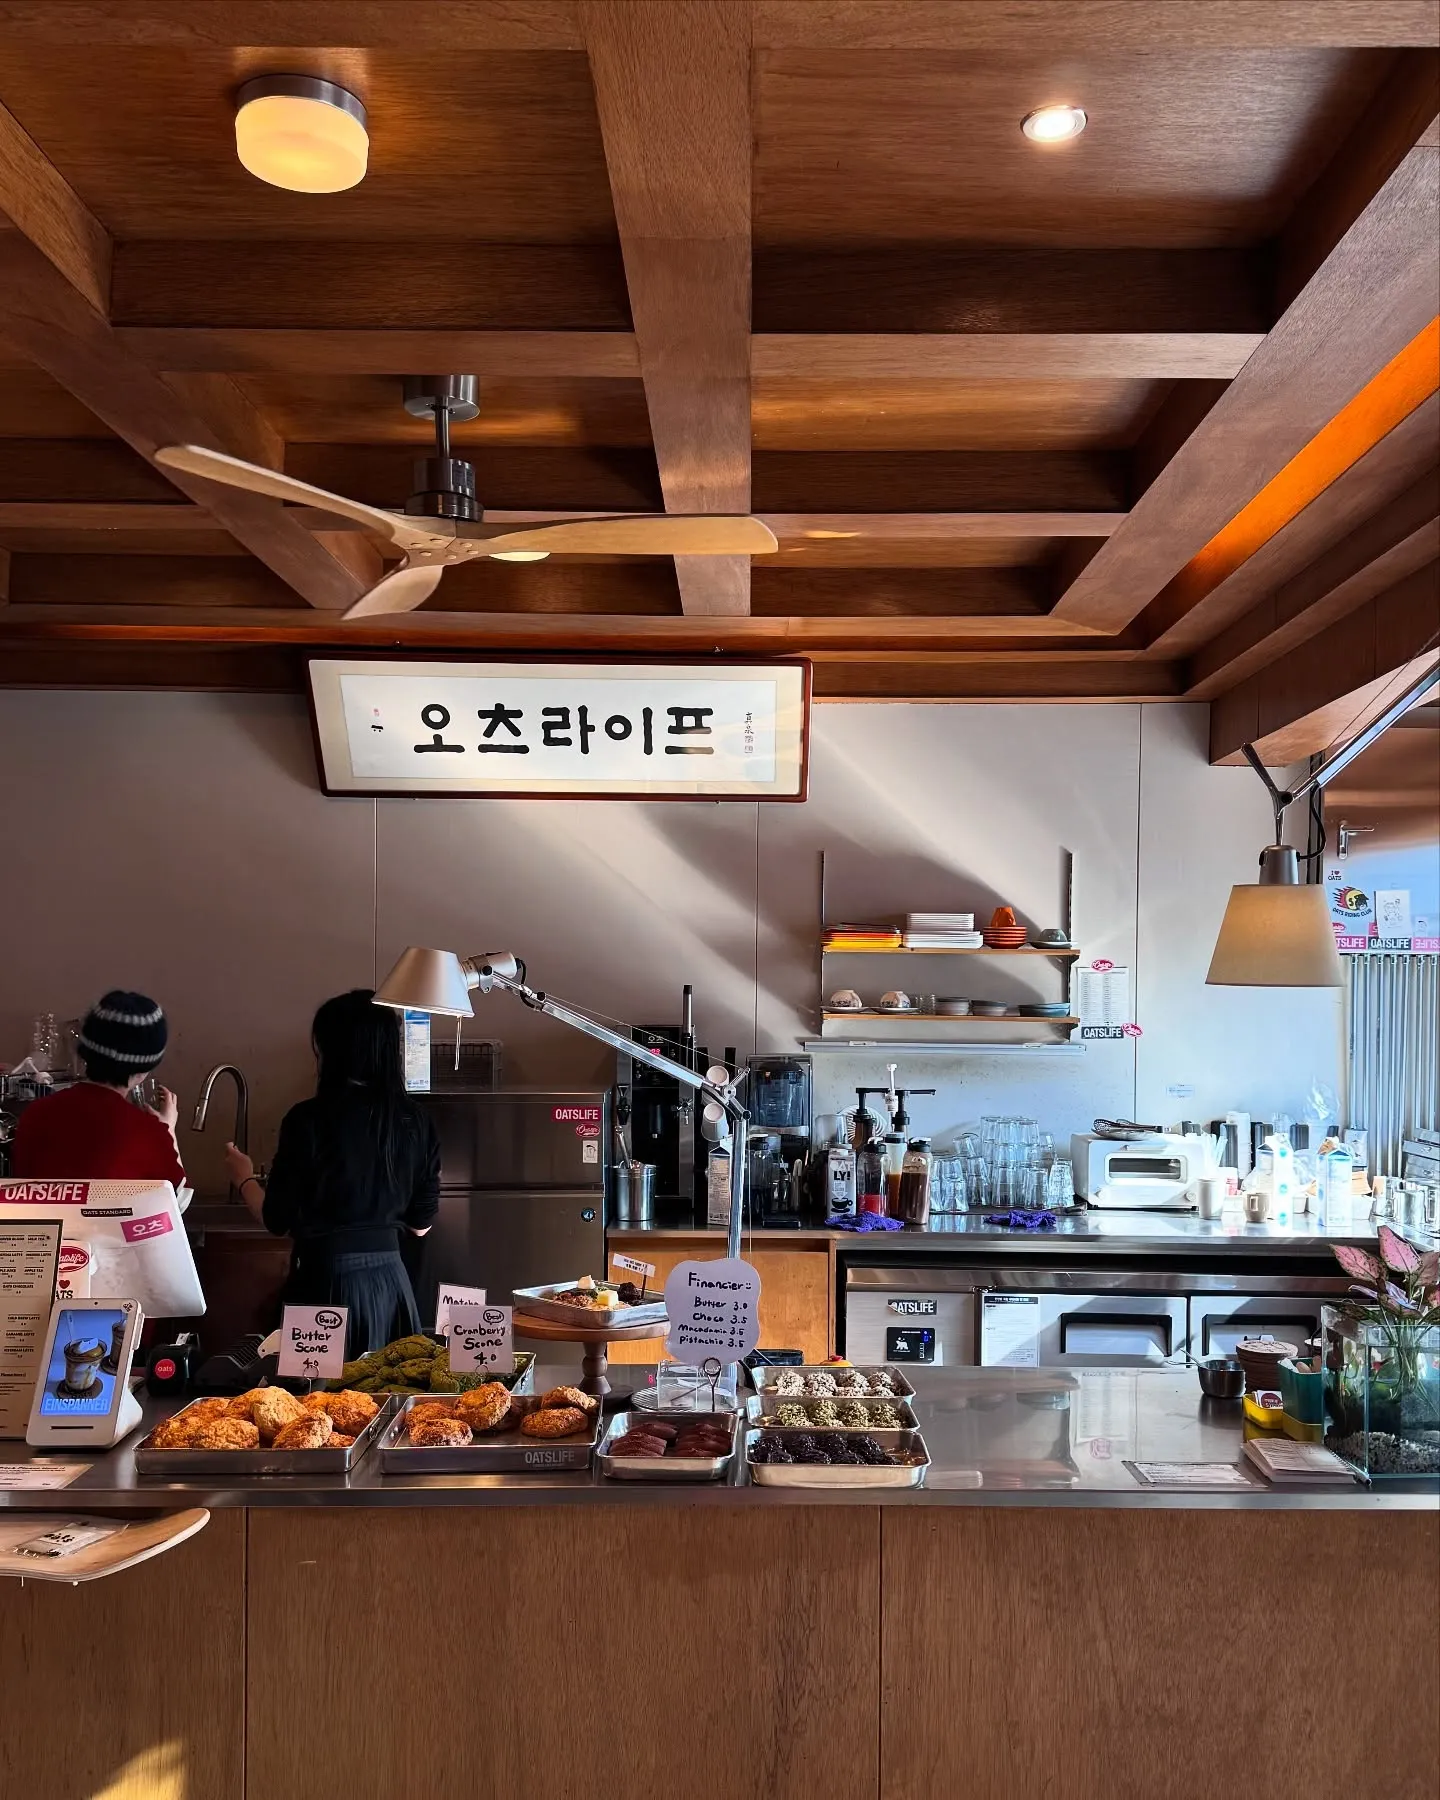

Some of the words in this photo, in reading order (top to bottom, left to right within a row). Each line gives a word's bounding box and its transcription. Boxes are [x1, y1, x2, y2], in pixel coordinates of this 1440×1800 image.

[413, 702, 715, 755] 오츠라이프
[1336, 938, 1364, 948] TSLIFE
[1370, 937, 1409, 949] OATSLIFE
[1083, 1027, 1122, 1038] OATSLIFE
[555, 1108, 599, 1120] OATSLIFE
[833, 1170, 851, 1181] LY!
[4, 1182, 84, 1201] OATSLIFE
[132, 1219, 165, 1237] 오츠
[688, 1271, 744, 1291] Financier
[56, 1289, 74, 1300] ATS
[694, 1295, 727, 1308] Butter
[733, 1301, 748, 1311] 3.0
[894, 1300, 934, 1313] ATSLIFE
[319, 1314, 338, 1326] Best
[692, 1312, 724, 1322] Choco
[730, 1314, 748, 1325] 3.5
[291, 1327, 332, 1342] Butter
[453, 1323, 506, 1337] Cranberry
[677, 1323, 728, 1334] Macadamia
[729, 1326, 745, 1336] 3.5
[294, 1341, 329, 1353] Scone
[463, 1337, 503, 1350] Scone
[727, 1337, 746, 1348] 3.5
[473, 1351, 497, 1365] 4.0
[525, 1450, 575, 1464] OATSLIFE
